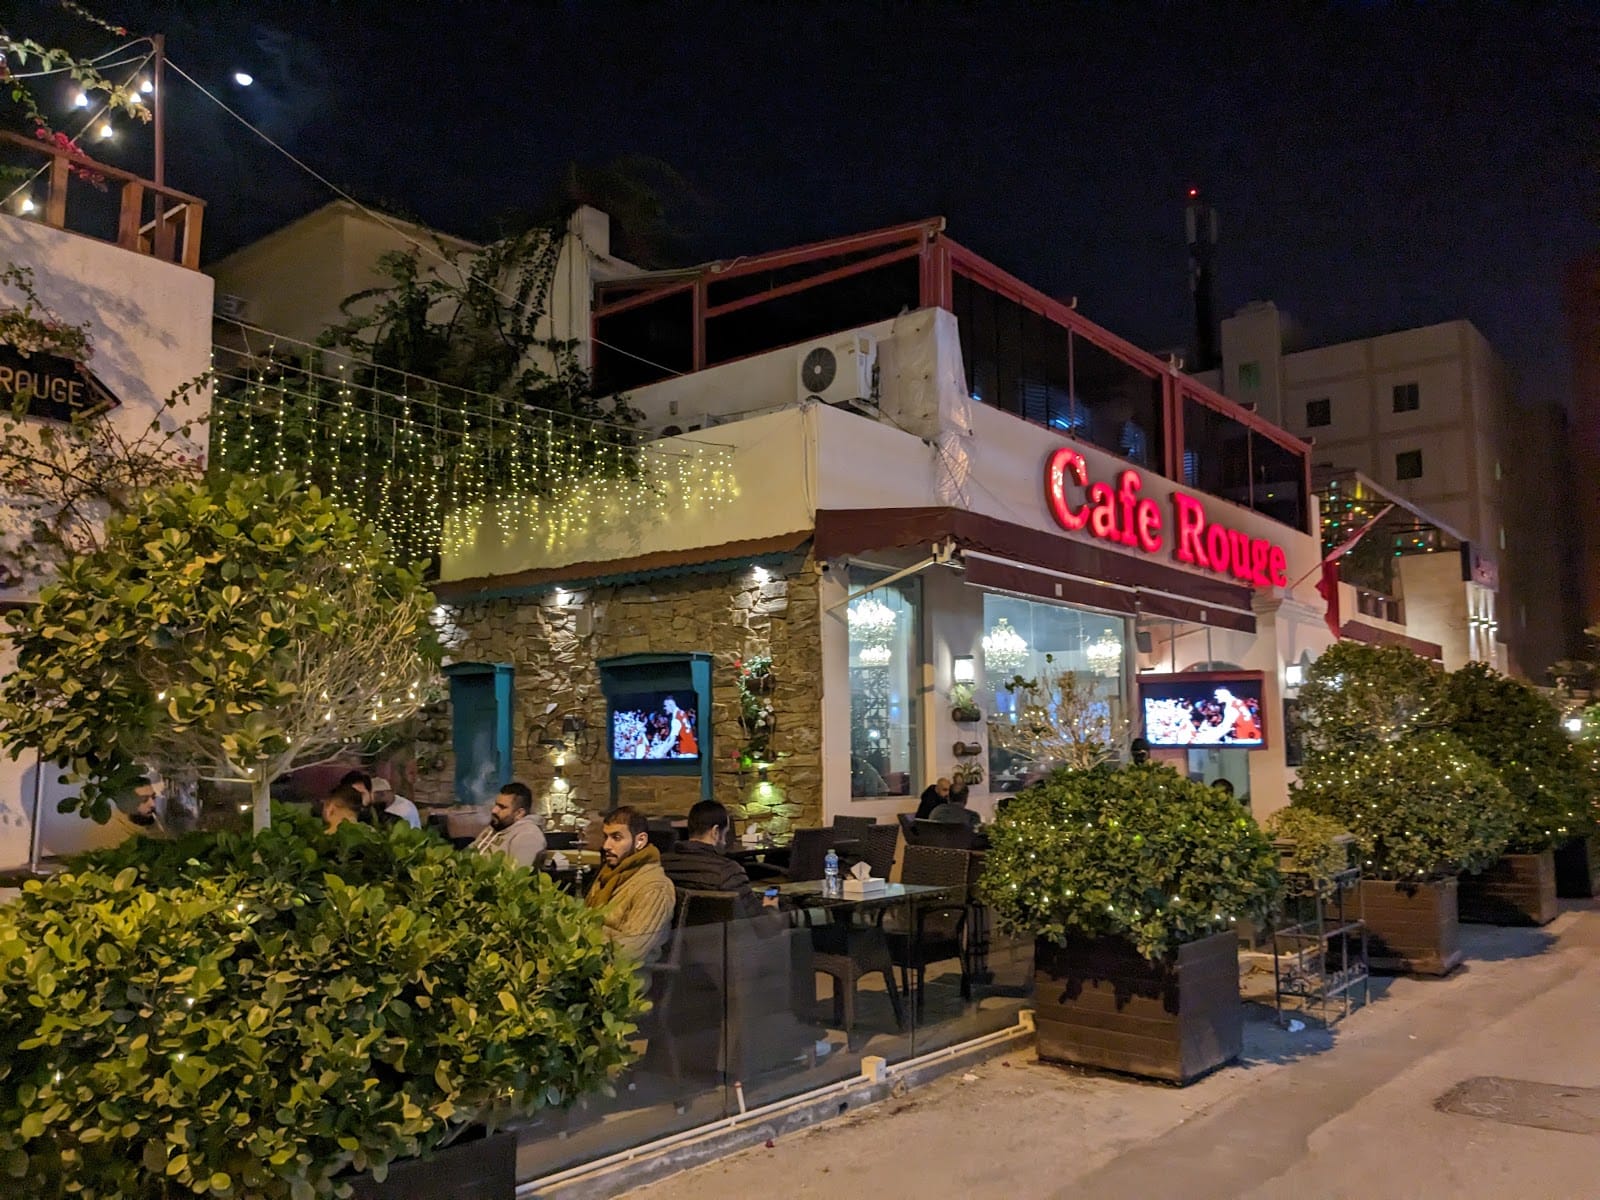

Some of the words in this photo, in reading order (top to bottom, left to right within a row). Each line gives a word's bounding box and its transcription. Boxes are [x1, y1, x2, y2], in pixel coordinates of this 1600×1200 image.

[0, 365, 85, 408] ROUGE
[1045, 447, 1163, 553] Cafe
[1171, 491, 1288, 588] Rouge
